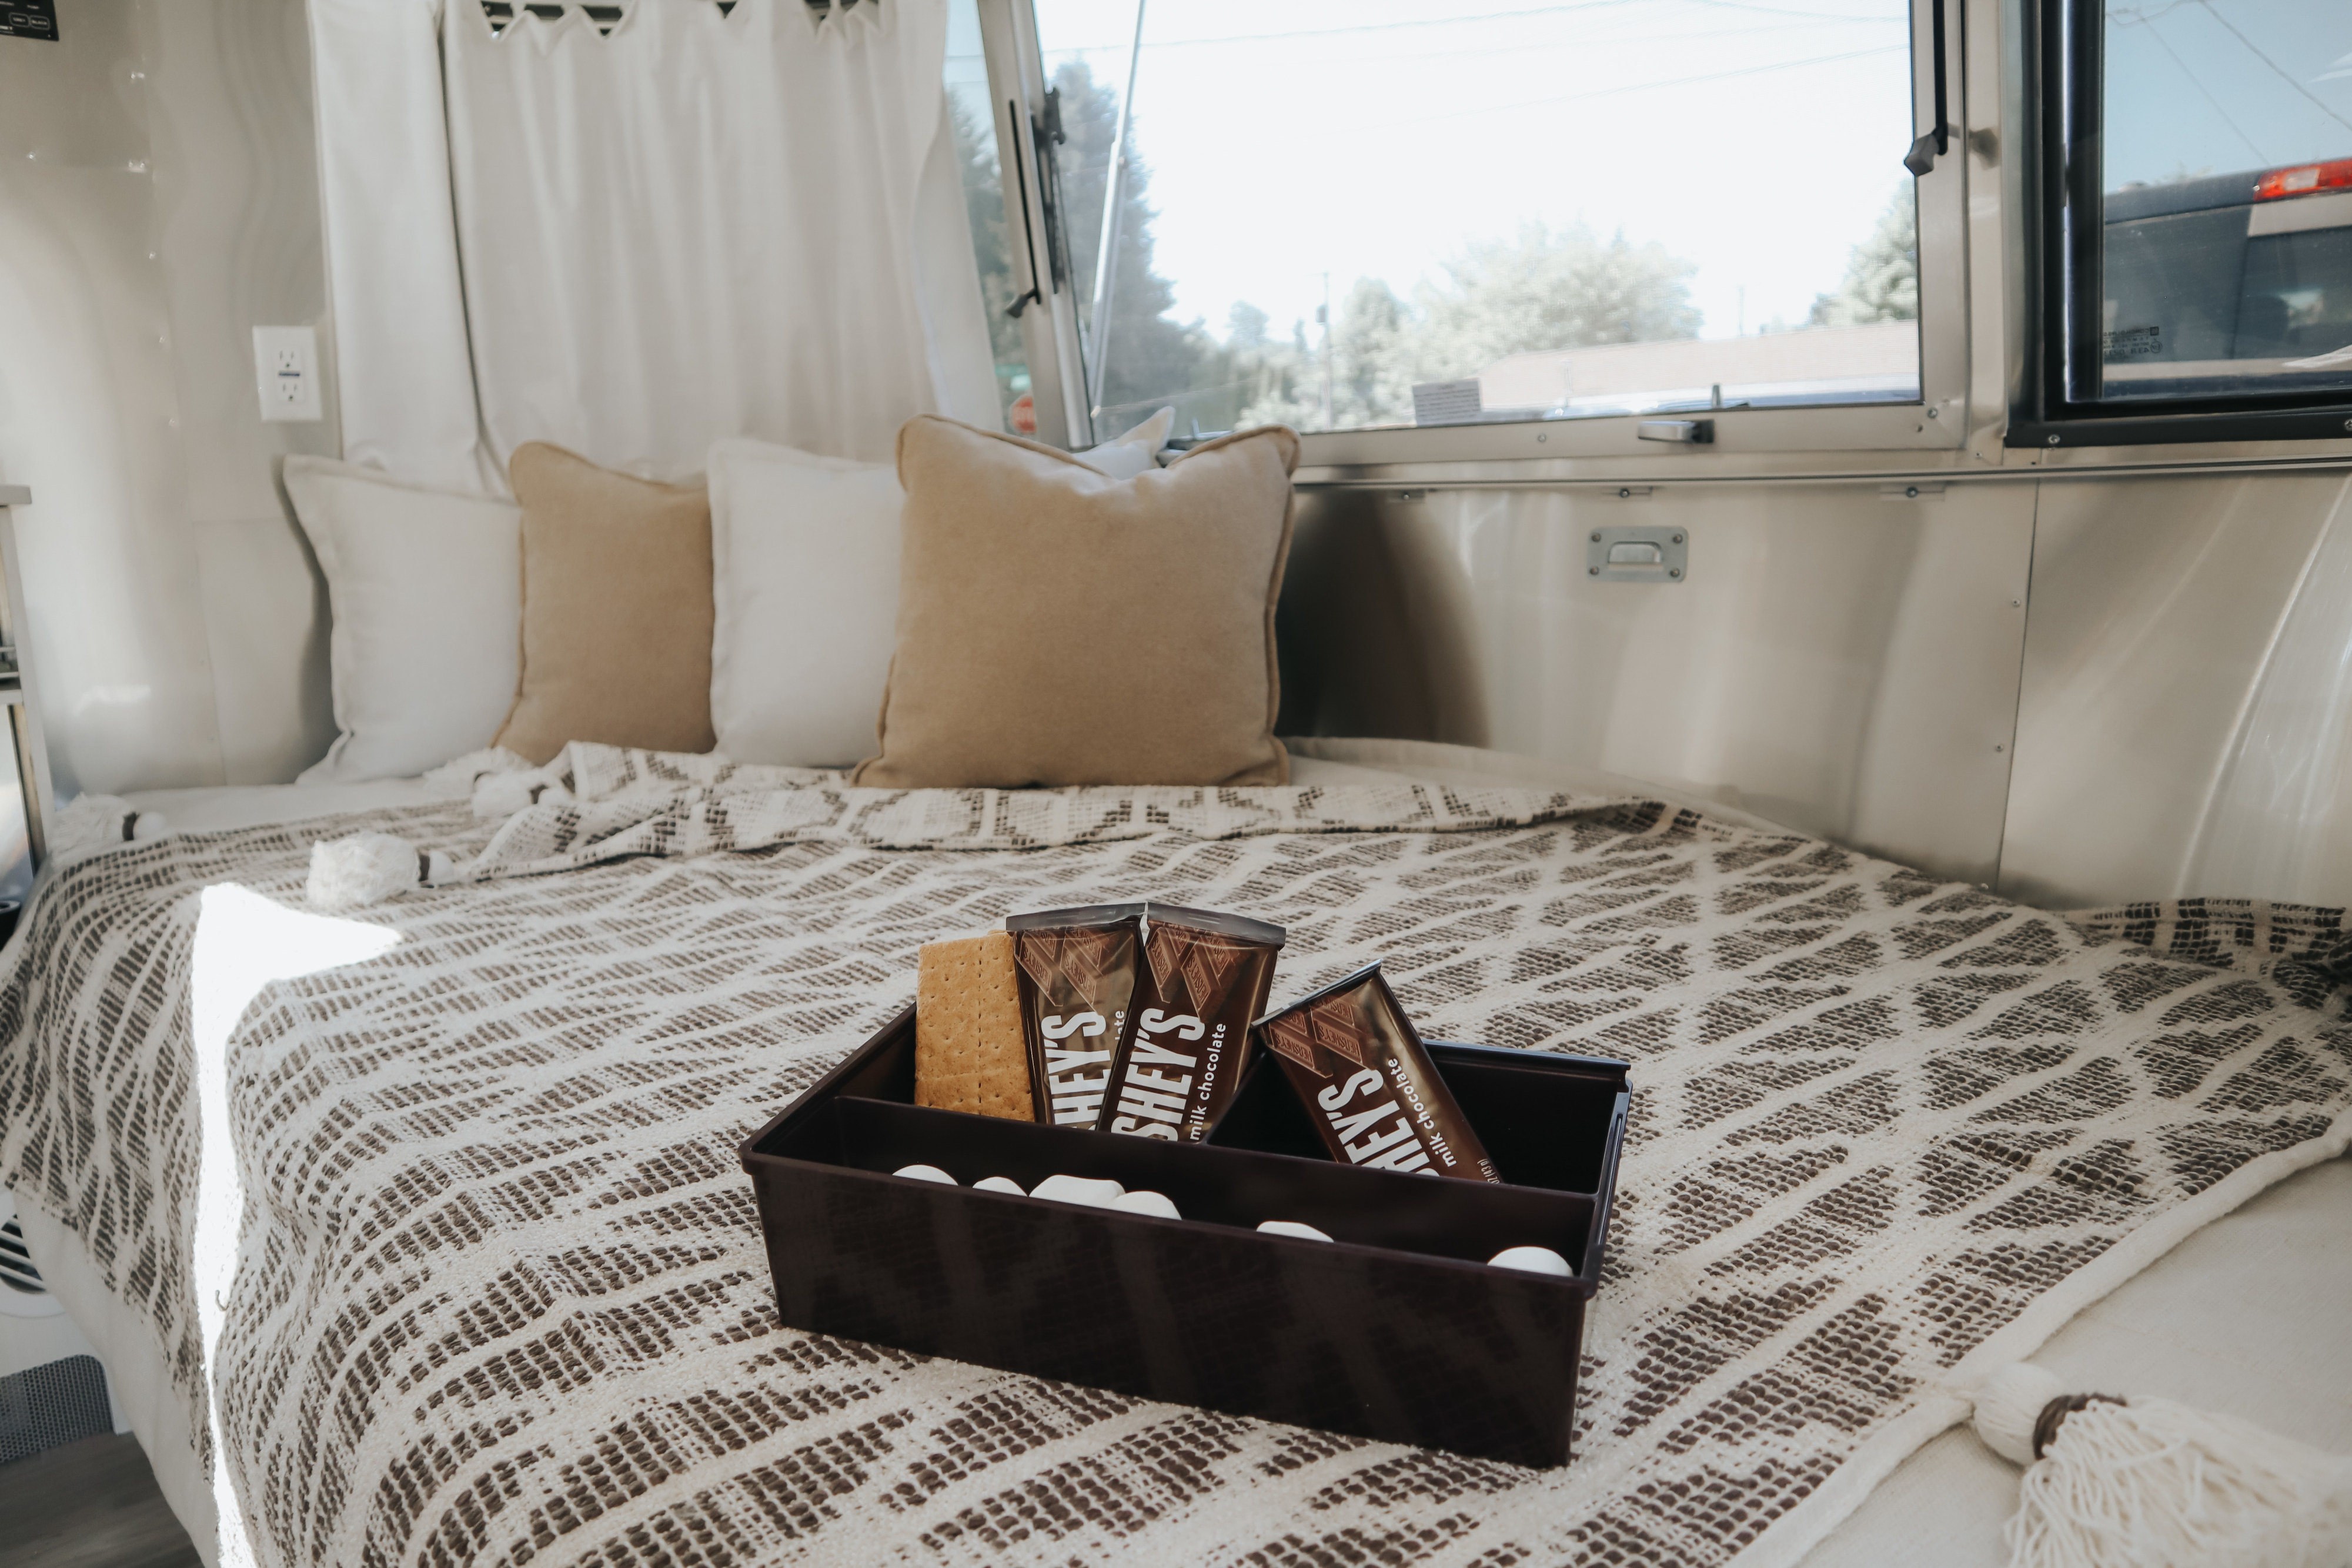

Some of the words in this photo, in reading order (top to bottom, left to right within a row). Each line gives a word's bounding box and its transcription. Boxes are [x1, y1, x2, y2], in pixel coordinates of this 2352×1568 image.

[1152, 939, 1170, 982] HERSHEY'S
[1188, 957, 1209, 1004] HERSHEY'S
[1197, 1023, 1227, 1101] chocolate
[1275, 1033, 1313, 1063] HERSHEY'S
[1318, 1025, 1361, 1057] HERSHEY'S
[1041, 1011, 1111, 1130] HEY'S
[1388, 1058, 1435, 1129] chocolate
[1189, 1105, 1207, 1141] milk
[1318, 1068, 1440, 1176] HEY'S
[1429, 1132, 1457, 1167] milk
